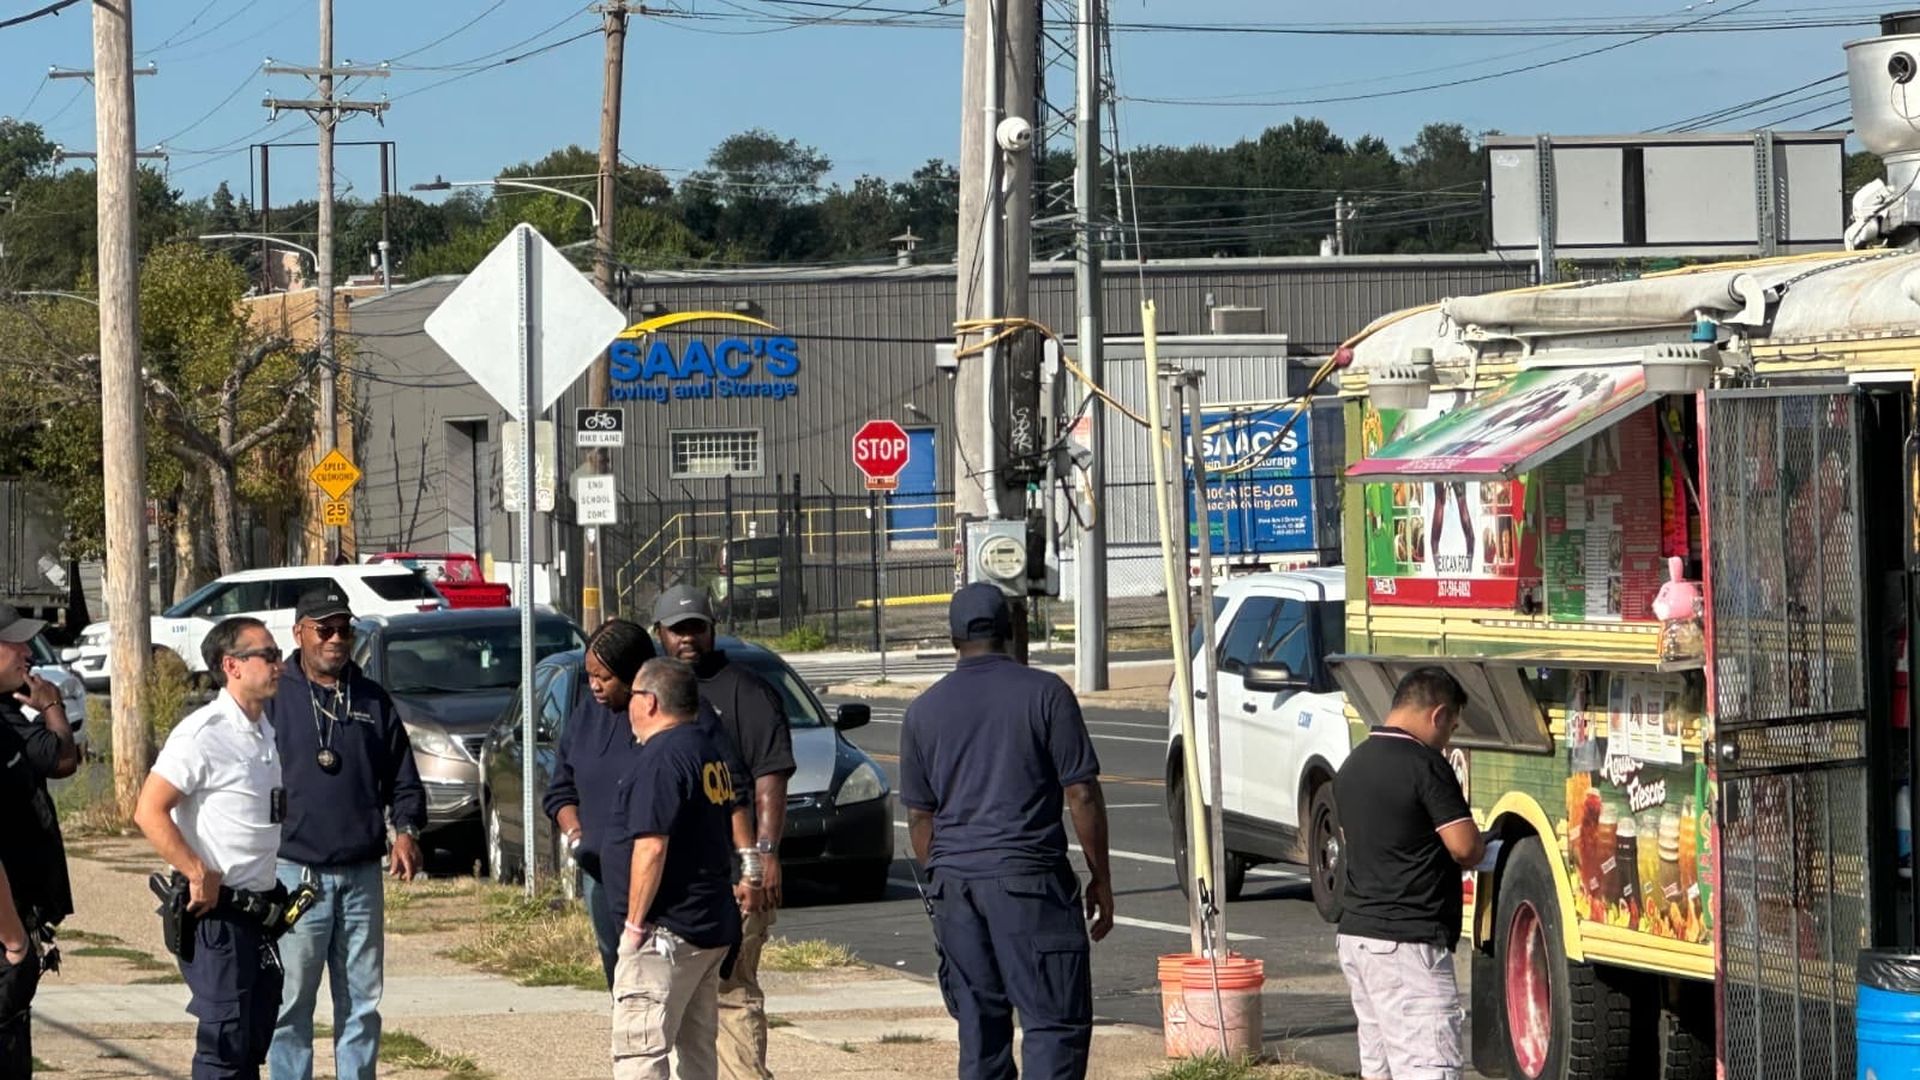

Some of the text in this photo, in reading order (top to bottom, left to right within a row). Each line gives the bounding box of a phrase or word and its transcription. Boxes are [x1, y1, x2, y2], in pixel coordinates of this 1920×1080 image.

[610, 336, 800, 381] SAAC'S
[611, 378, 797, 403] oving and Storage
[579, 434, 620, 442] BIKE LANE
[857, 438, 905, 460] STOP
[323, 463, 346, 471] SPEED
[588, 481, 603, 490] END
[582, 496, 611, 505] SCHOOL
[326, 504, 346, 517] 25
[587, 510, 607, 519] ZONE
